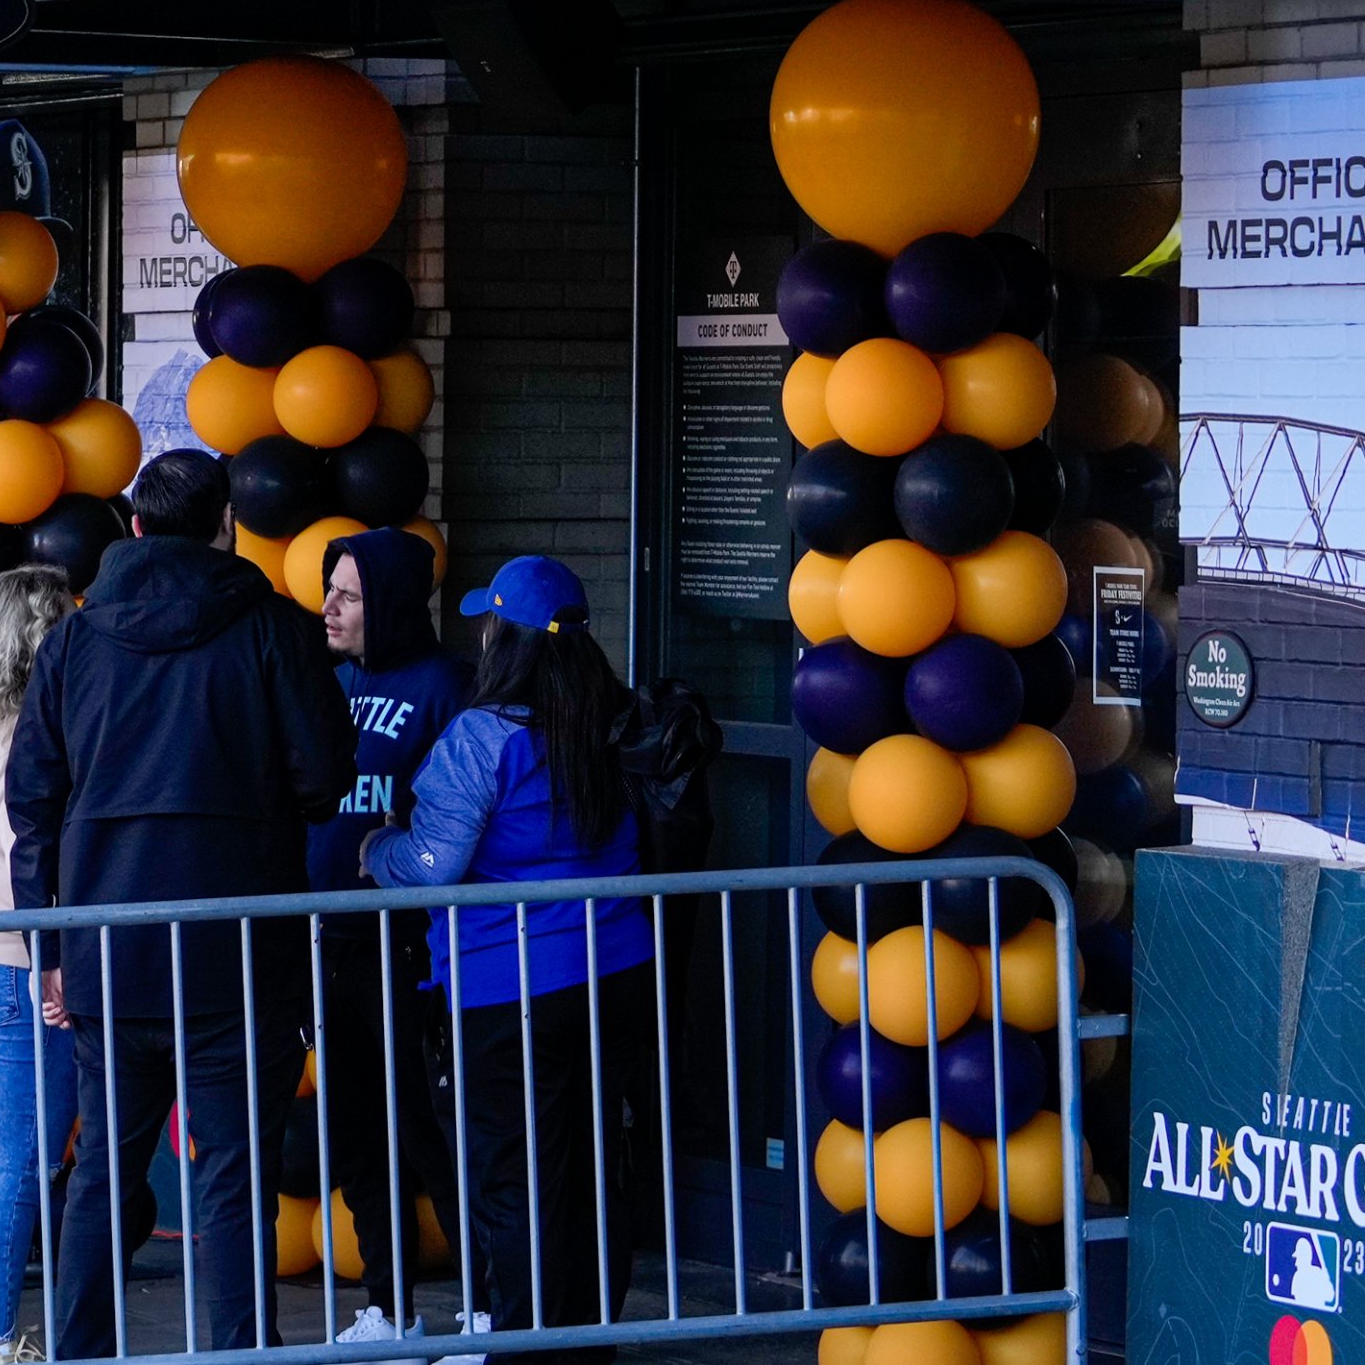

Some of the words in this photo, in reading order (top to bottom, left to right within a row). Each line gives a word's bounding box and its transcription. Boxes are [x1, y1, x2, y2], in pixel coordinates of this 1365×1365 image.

[707, 294, 739, 308] T-MOBILE
[740, 293, 760, 307] PARK
[698, 324, 718, 338] CODE
[719, 324, 730, 338] OF
[732, 323, 768, 337] CONDUCT
[1208, 640, 1226, 663] No
[1188, 664, 1246, 697] Smoking
[1262, 1091, 1351, 1137] SEATTLE
[1142, 1111, 1226, 1201] ALL
[1231, 1125, 1340, 1222] STAR
[1243, 1220, 1263, 1256] 20
[1343, 1238, 1365, 1275] 23
